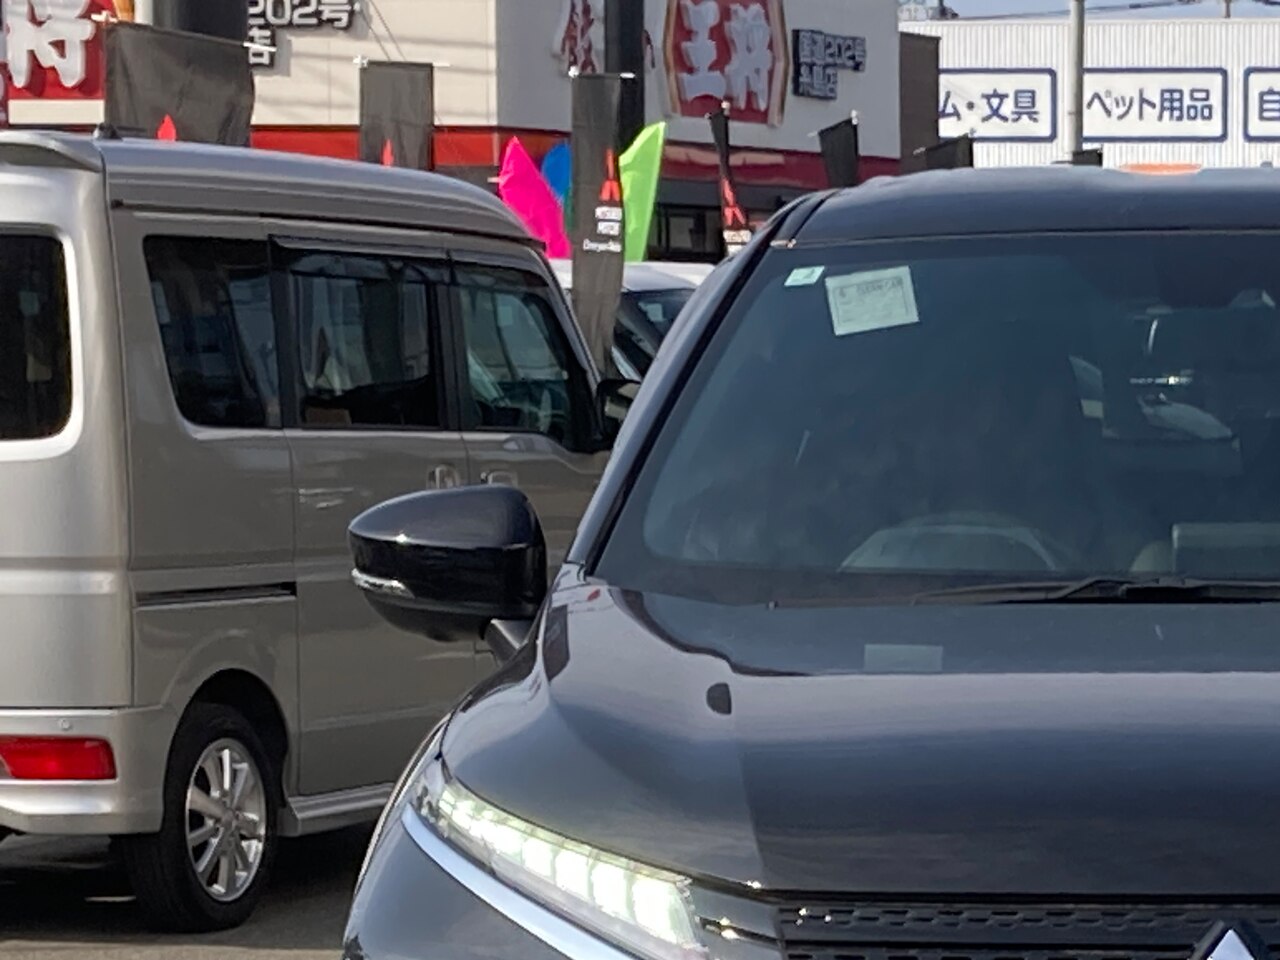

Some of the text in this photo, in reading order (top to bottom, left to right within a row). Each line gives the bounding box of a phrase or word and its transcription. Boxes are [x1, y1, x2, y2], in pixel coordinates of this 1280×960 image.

[1086, 88, 1213, 122] ペット用品
